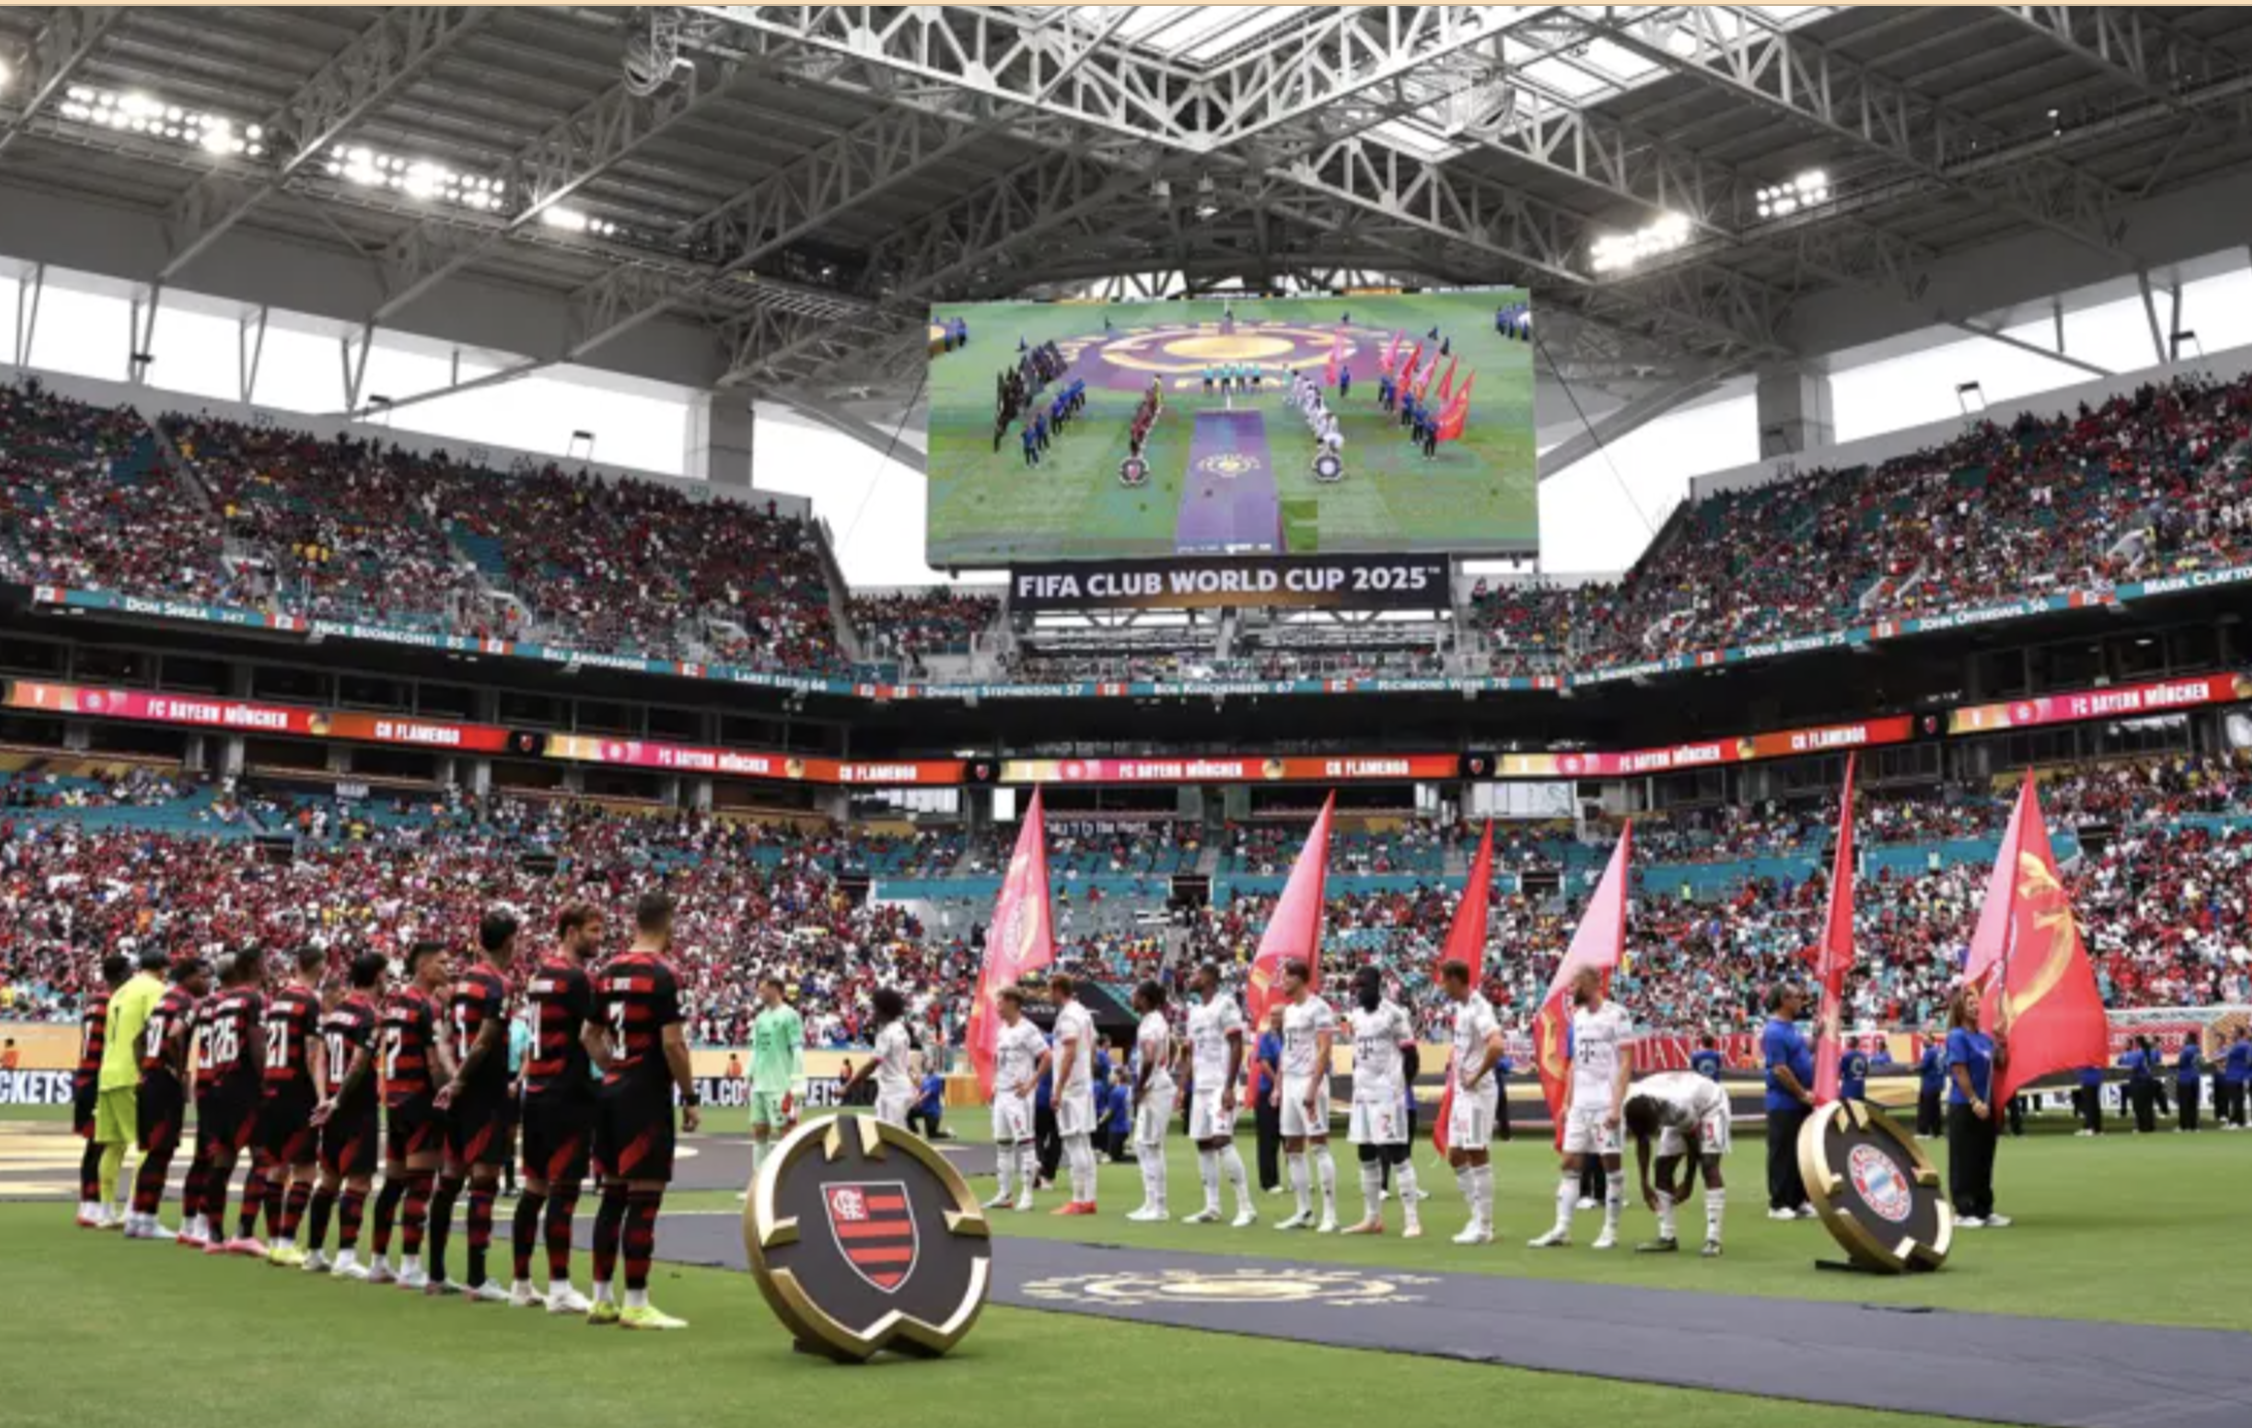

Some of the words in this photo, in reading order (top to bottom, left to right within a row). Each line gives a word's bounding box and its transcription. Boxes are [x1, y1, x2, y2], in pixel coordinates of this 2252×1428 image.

[1018, 575, 1080, 598] FIFA
[1088, 573, 1161, 595] CLUB
[1170, 569, 1278, 593] WORLD
[1285, 568, 1345, 591] CUP
[2144, 577, 2188, 594] MARK
[126, 597, 159, 614] DON
[165, 602, 209, 620] SHULA
[1920, 616, 1952, 631] JOHN
[314, 620, 347, 636] NICK
[353, 625, 437, 647] BUONICONTI
[542, 647, 568, 661] BILL
[734, 670, 771, 685] LARRY
[982, 684, 1061, 697] STEPHENSON
[2071, 696, 2087, 715] FC
[2091, 690, 2139, 713] BAYERN
[2144, 682, 2210, 706] MÜNCHEN
[147, 698, 165, 716] FC
[169, 701, 219, 721] BAYERN
[223, 704, 288, 728] MÜNCHEN
[396, 724, 461, 743] FLAMENGO
[1809, 726, 1866, 747] FLAMENGO
[658, 748, 673, 764] FC
[1619, 755, 1631, 771] FC
[856, 764, 917, 780] FLAMENGO
[1119, 763, 1134, 778] FC
[1346, 760, 1409, 775] FLAMENGO
[265, 1019, 290, 1068] 21
[386, 1027, 402, 1080] 7
[0, 1071, 74, 1104] CKETS
